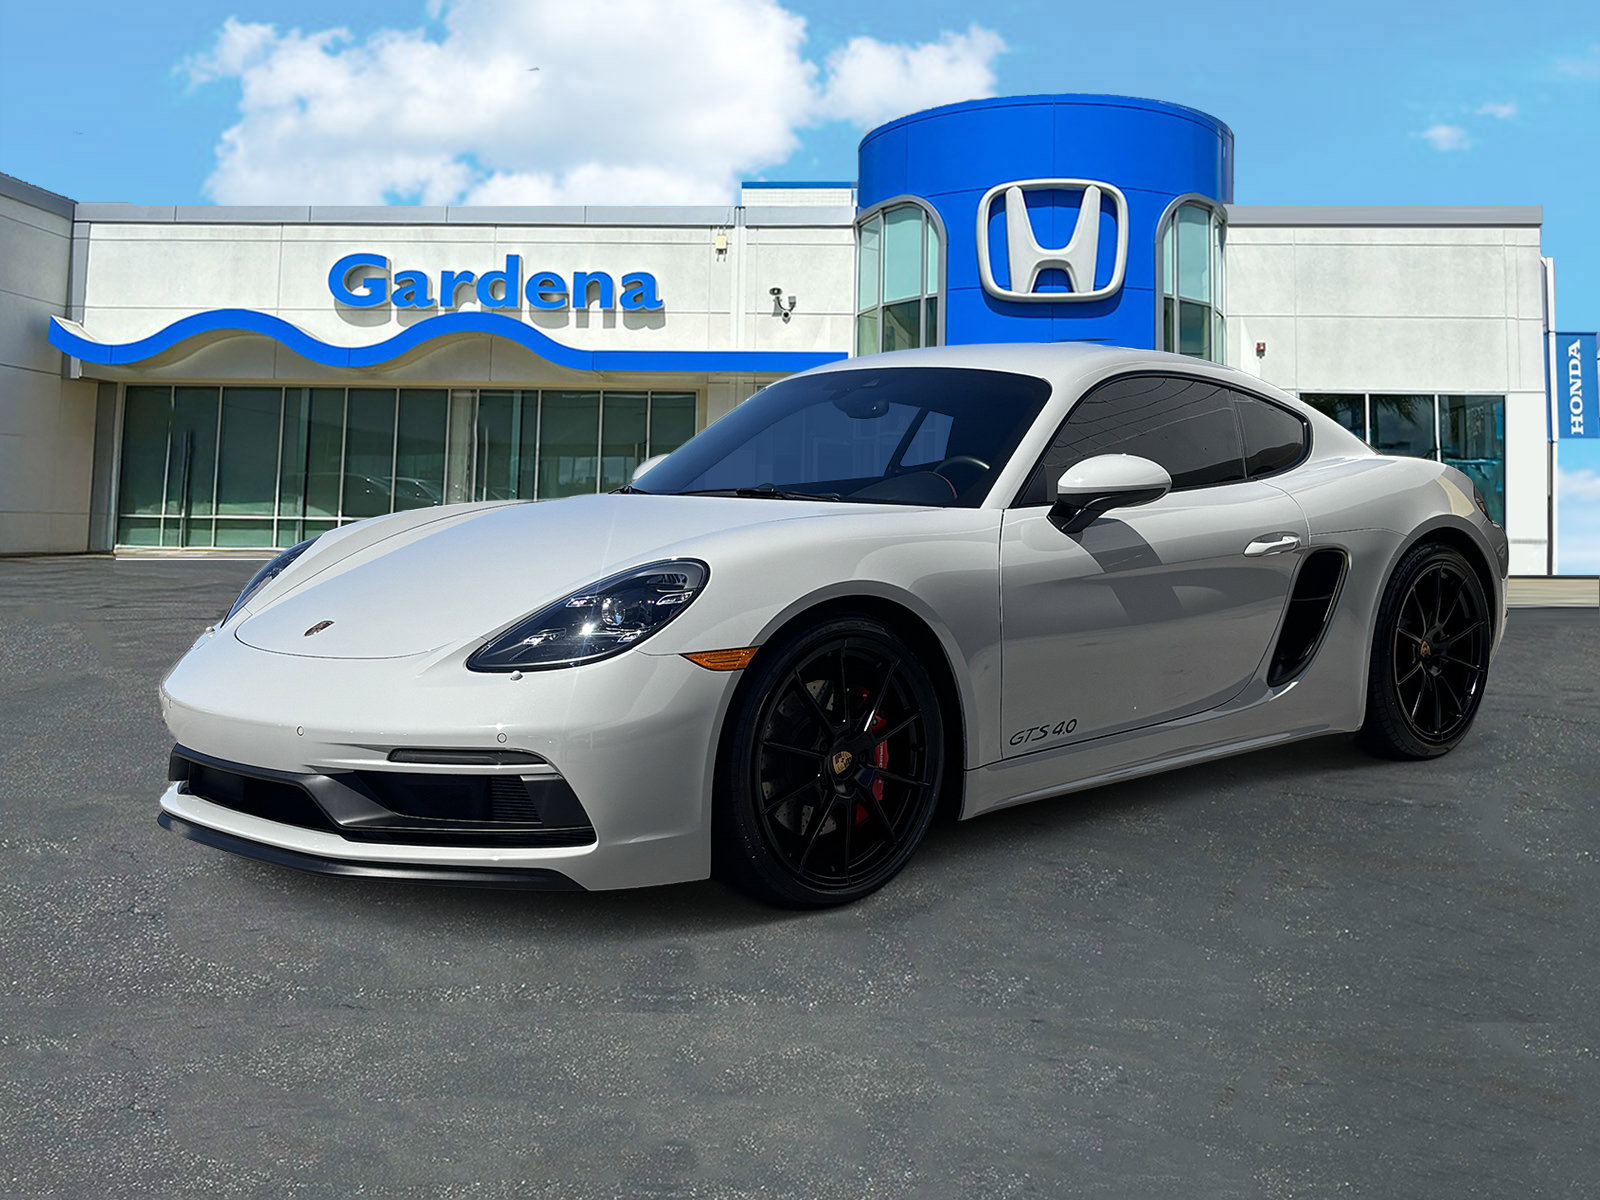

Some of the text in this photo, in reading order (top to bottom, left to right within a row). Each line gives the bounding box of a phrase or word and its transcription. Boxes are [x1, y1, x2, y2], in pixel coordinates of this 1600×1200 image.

[327, 252, 665, 311] Gardena
[1568, 339, 1585, 435] HONDA
[1009, 718, 1078, 746] GTS 4.0
